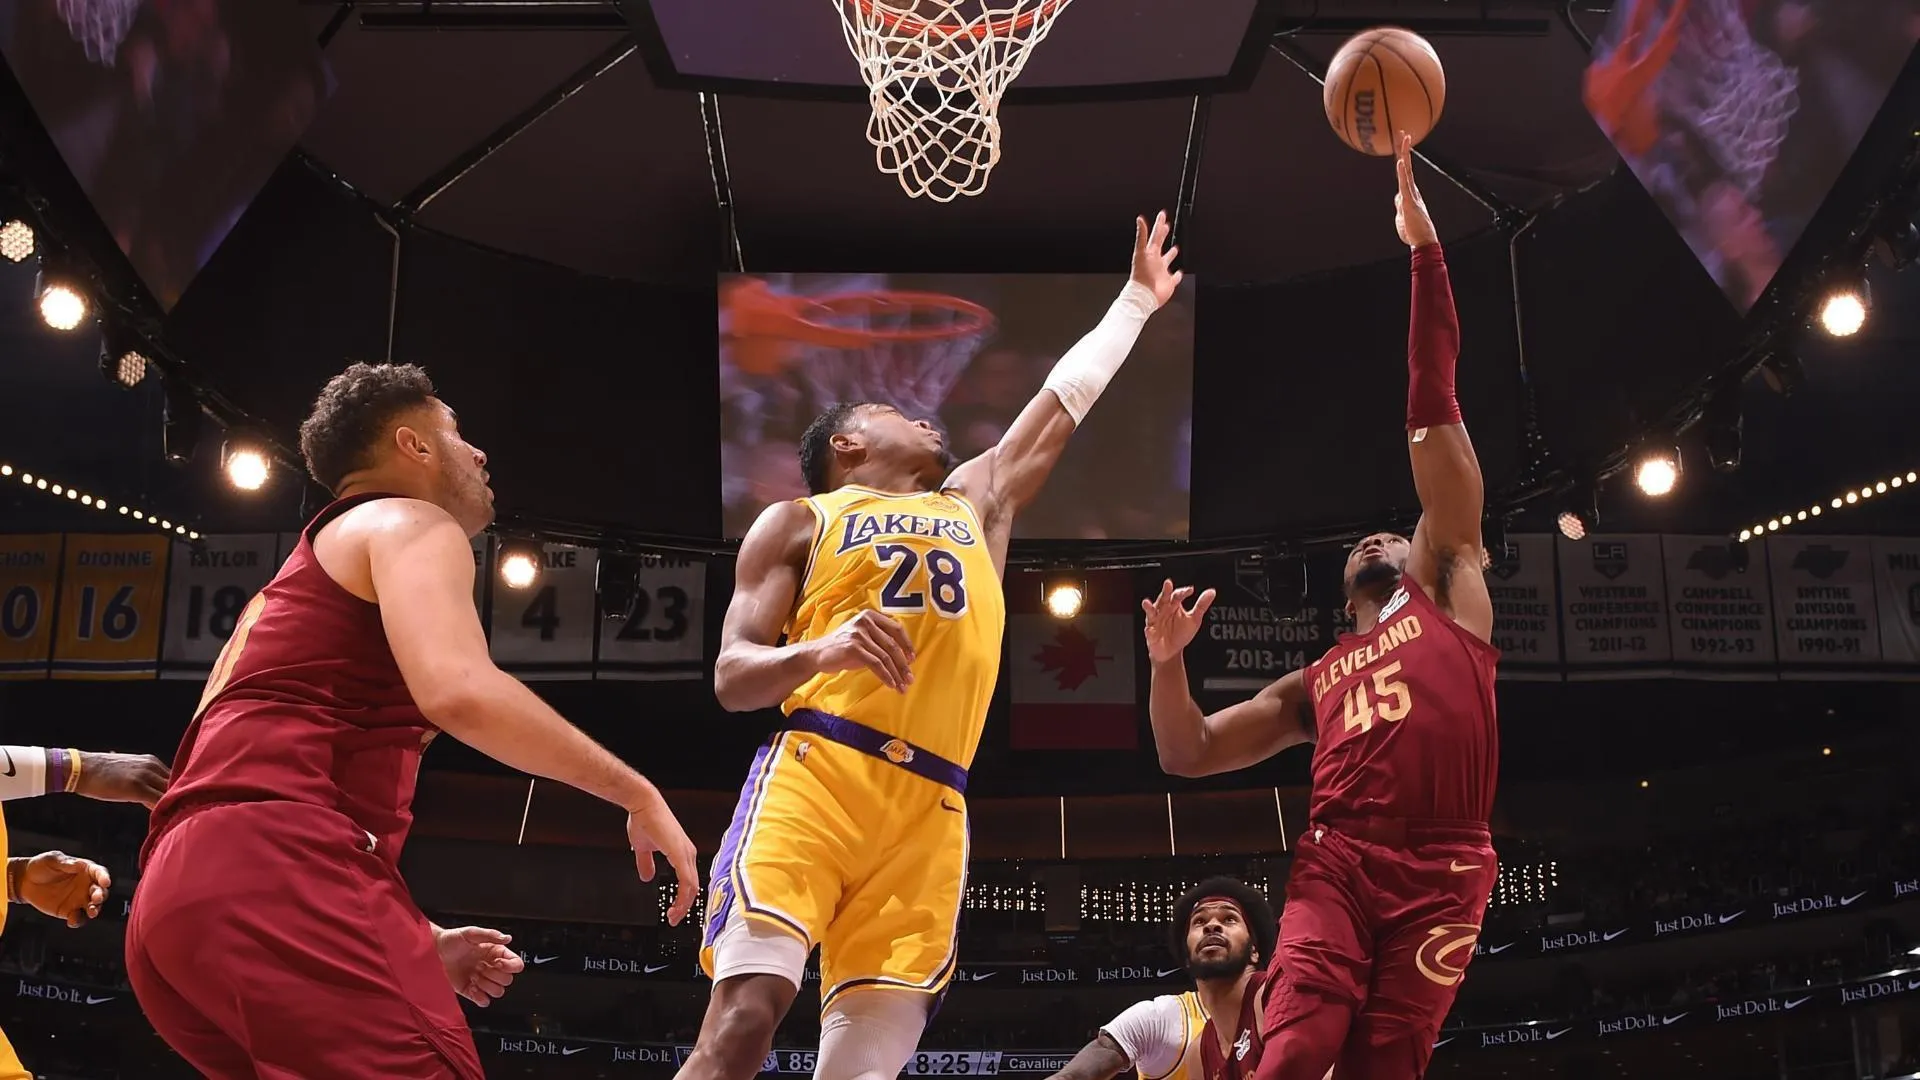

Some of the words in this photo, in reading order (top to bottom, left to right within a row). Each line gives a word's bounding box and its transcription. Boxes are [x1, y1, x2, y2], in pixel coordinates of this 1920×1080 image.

[836, 513, 976, 556] LAKERS
[78, 551, 152, 567] DIONNE
[189, 551, 258, 567] TAYLOR
[1594, 545, 1626, 559] LA
[874, 544, 967, 617] 28
[1579, 586, 1647, 598] WESTERN
[1682, 587, 1754, 600] CAMPBELL
[1797, 587, 1851, 600] SMYTHE
[78, 586, 138, 640] 16
[186, 585, 247, 639] 18
[521, 586, 560, 642] 4
[616, 586, 689, 642] 23
[1210, 606, 1272, 622] STANLE
[1569, 602, 1660, 615] CONFERENCE
[1675, 602, 1765, 615] CONFERENCE
[1795, 602, 1856, 615] DIVISION
[1575, 617, 1657, 631] CHAMPIONS
[1681, 618, 1762, 631] CHAMPIONS
[1787, 618, 1867, 631] CHAMPIONS
[1209, 624, 1320, 642] CHAMPIONS
[1589, 637, 1647, 652] 2011-12
[1691, 637, 1754, 653] 1992-93
[1798, 637, 1860, 653] 1990-91
[1226, 649, 1306, 669] 2013-14
[1313, 615, 1423, 703] CLEVELAND
[1343, 660, 1412, 734] 45
[1893, 879, 1920, 899] Just
[1772, 901, 1798, 919] Just
[1800, 897, 1822, 912] Do
[1823, 894, 1837, 908] It.
[1654, 919, 1679, 937] Just
[1681, 915, 1702, 930] Do
[1703, 913, 1716, 926] It.
[1541, 936, 1565, 952] Just
[1567, 934, 1588, 947] Do
[1589, 932, 1600, 944] It.
[583, 956, 607, 971] Just
[609, 959, 629, 972] Do
[630, 961, 640, 973] It.
[1021, 969, 1044, 984] Just
[1046, 969, 1066, 981] Do
[1067, 968, 1079, 981] It.
[1096, 968, 1120, 983] Just
[1121, 966, 1141, 979] Do
[1142, 966, 1153, 978] It.
[17, 980, 43, 997] Just
[46, 985, 68, 1001] Do
[70, 989, 82, 1003] It.
[1840, 986, 1867, 1006] Just
[1868, 982, 1891, 997] Do
[1892, 979, 1905, 993] It.
[1716, 1003, 1743, 1022] Just
[1744, 1000, 1766, 1015] Do
[1768, 998, 1781, 1011] It.
[1598, 1019, 1623, 1037] Just
[1624, 1016, 1646, 1030] Do
[1647, 1014, 1660, 1027] It.
[499, 1038, 525, 1052] Just
[526, 1040, 546, 1053] Do
[548, 1042, 559, 1055] It.
[1481, 1032, 1506, 1048] Just
[1508, 1029, 1529, 1043] Do
[1530, 1028, 1543, 1041] It.
[613, 1047, 637, 1062] Just
[639, 1049, 659, 1061] Do
[661, 1050, 672, 1062] It.
[789, 1053, 816, 1071] 85
[916, 1054, 970, 1073] 8:25
[986, 1058, 996, 1073] 4
[1009, 1058, 1069, 1070] Cavaliers
